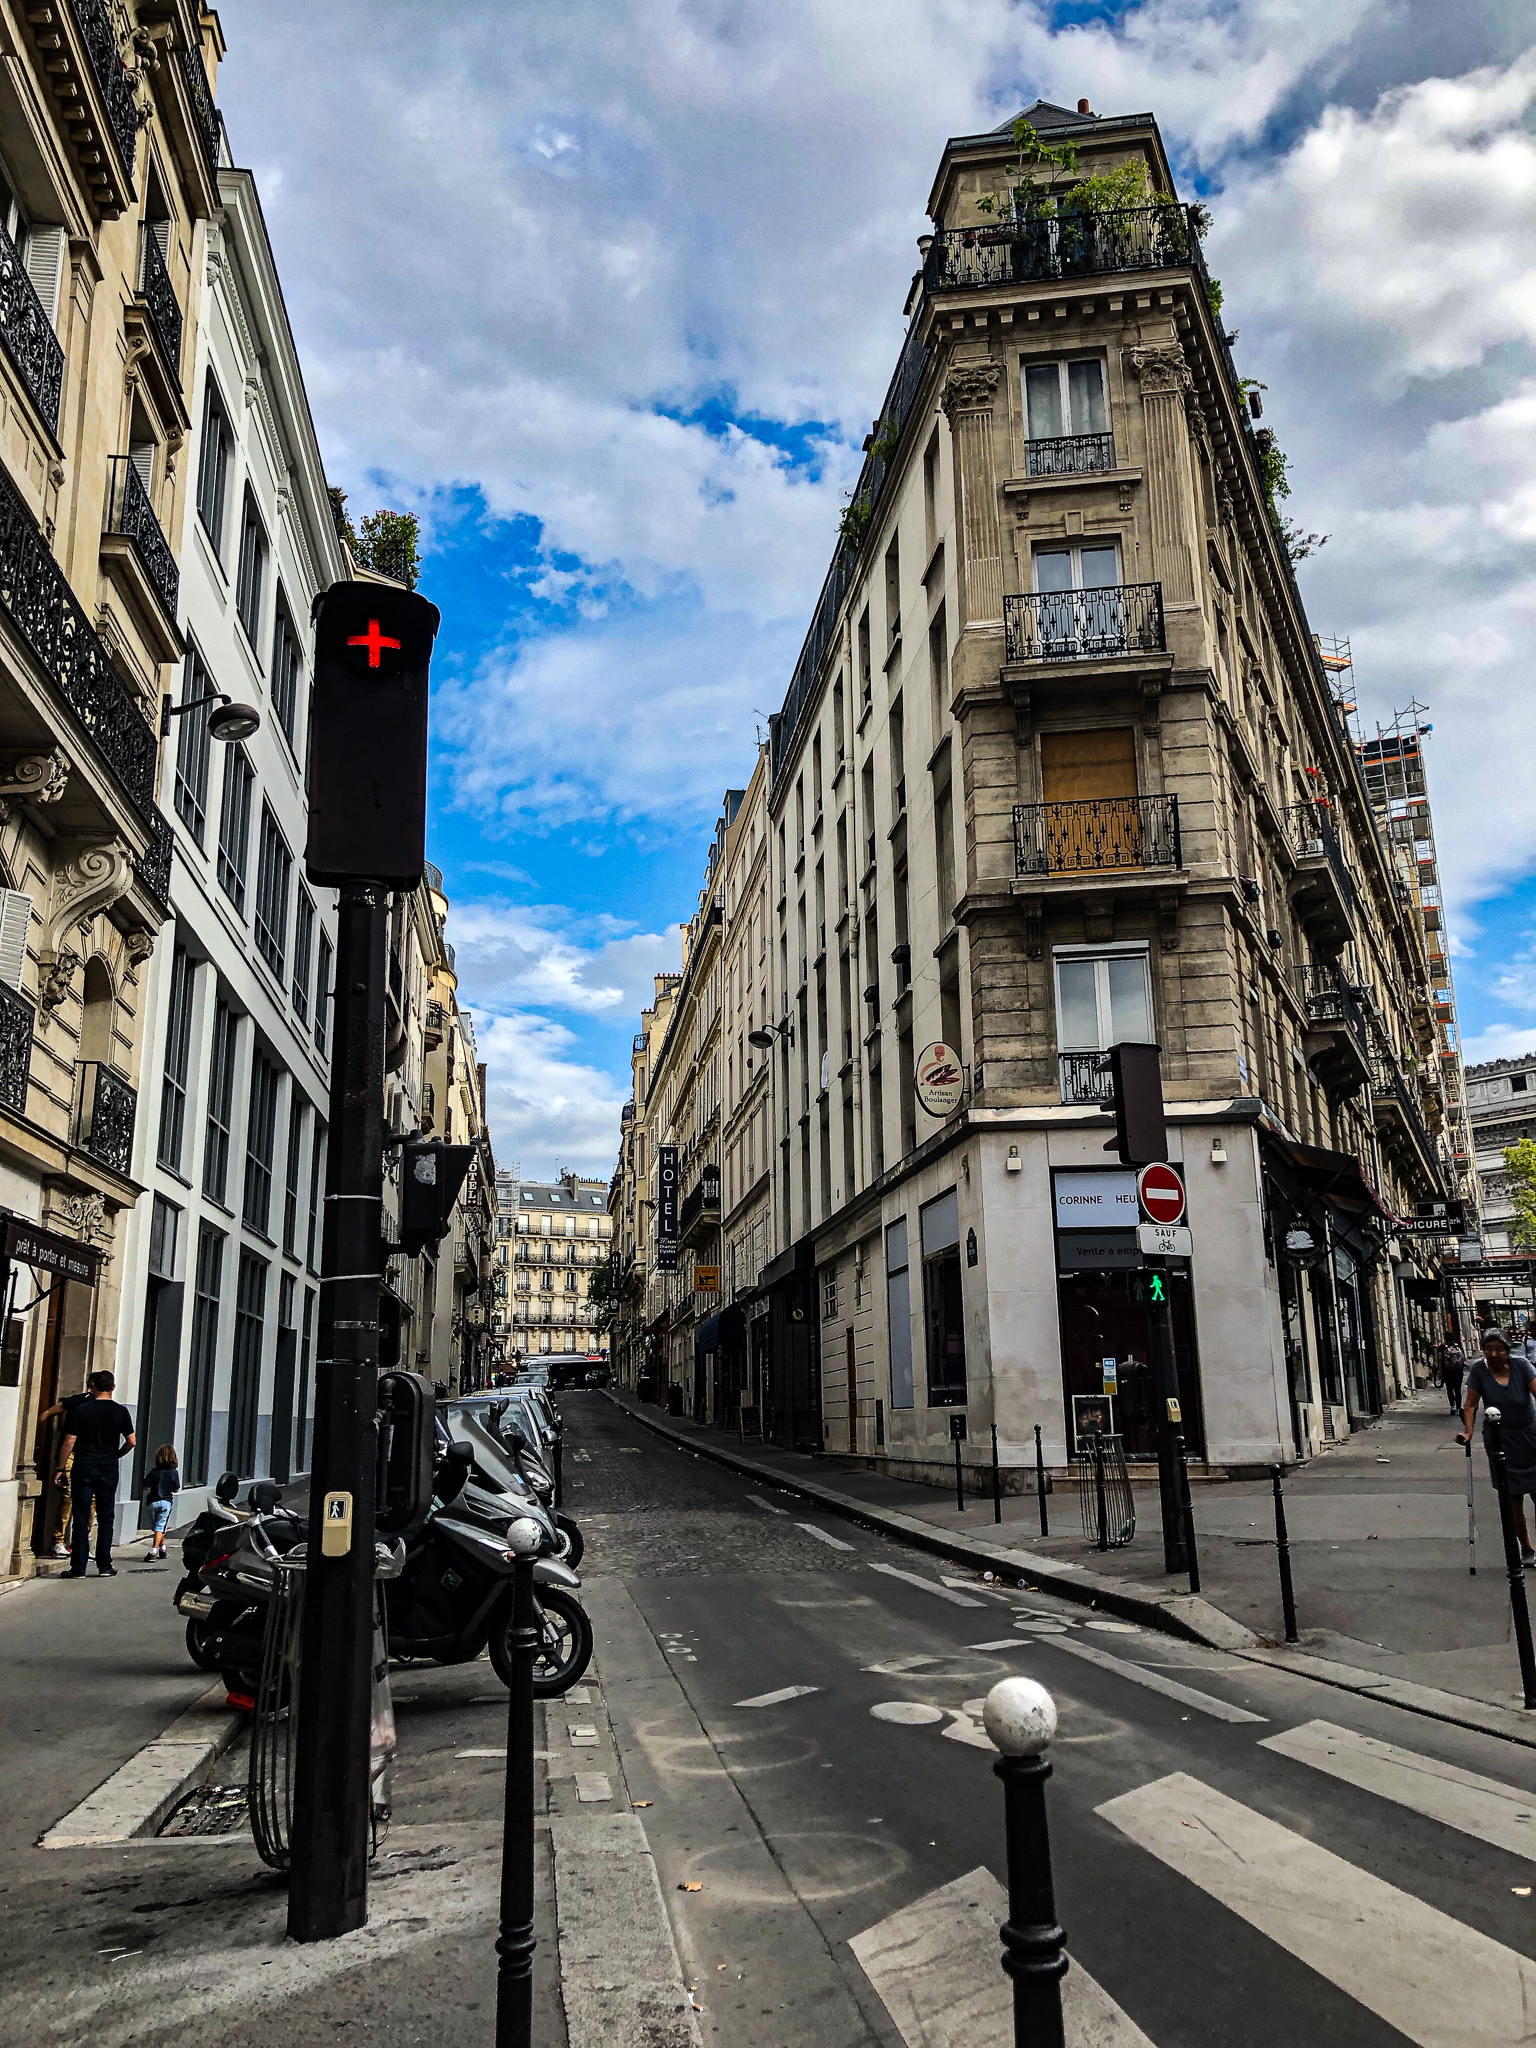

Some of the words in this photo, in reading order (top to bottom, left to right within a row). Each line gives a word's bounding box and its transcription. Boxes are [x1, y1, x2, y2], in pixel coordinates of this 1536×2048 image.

[924, 1096, 959, 1105] Boulanger
[662, 1153, 674, 1232] HOTEL
[1059, 1195, 1103, 1205] CORINNE
[1115, 1194, 1137, 1204] HEU
[1391, 1219, 1448, 1230] PDICURE
[1154, 1228, 1177, 1237] SAUF
[1075, 1247, 1105, 1256] Vente
[15, 1239, 30, 1255] prêt
[31, 1242, 37, 1257] à
[38, 1248, 59, 1265] porter
[60, 1255, 67, 1268] et
[68, 1259, 89, 1276] mesure
